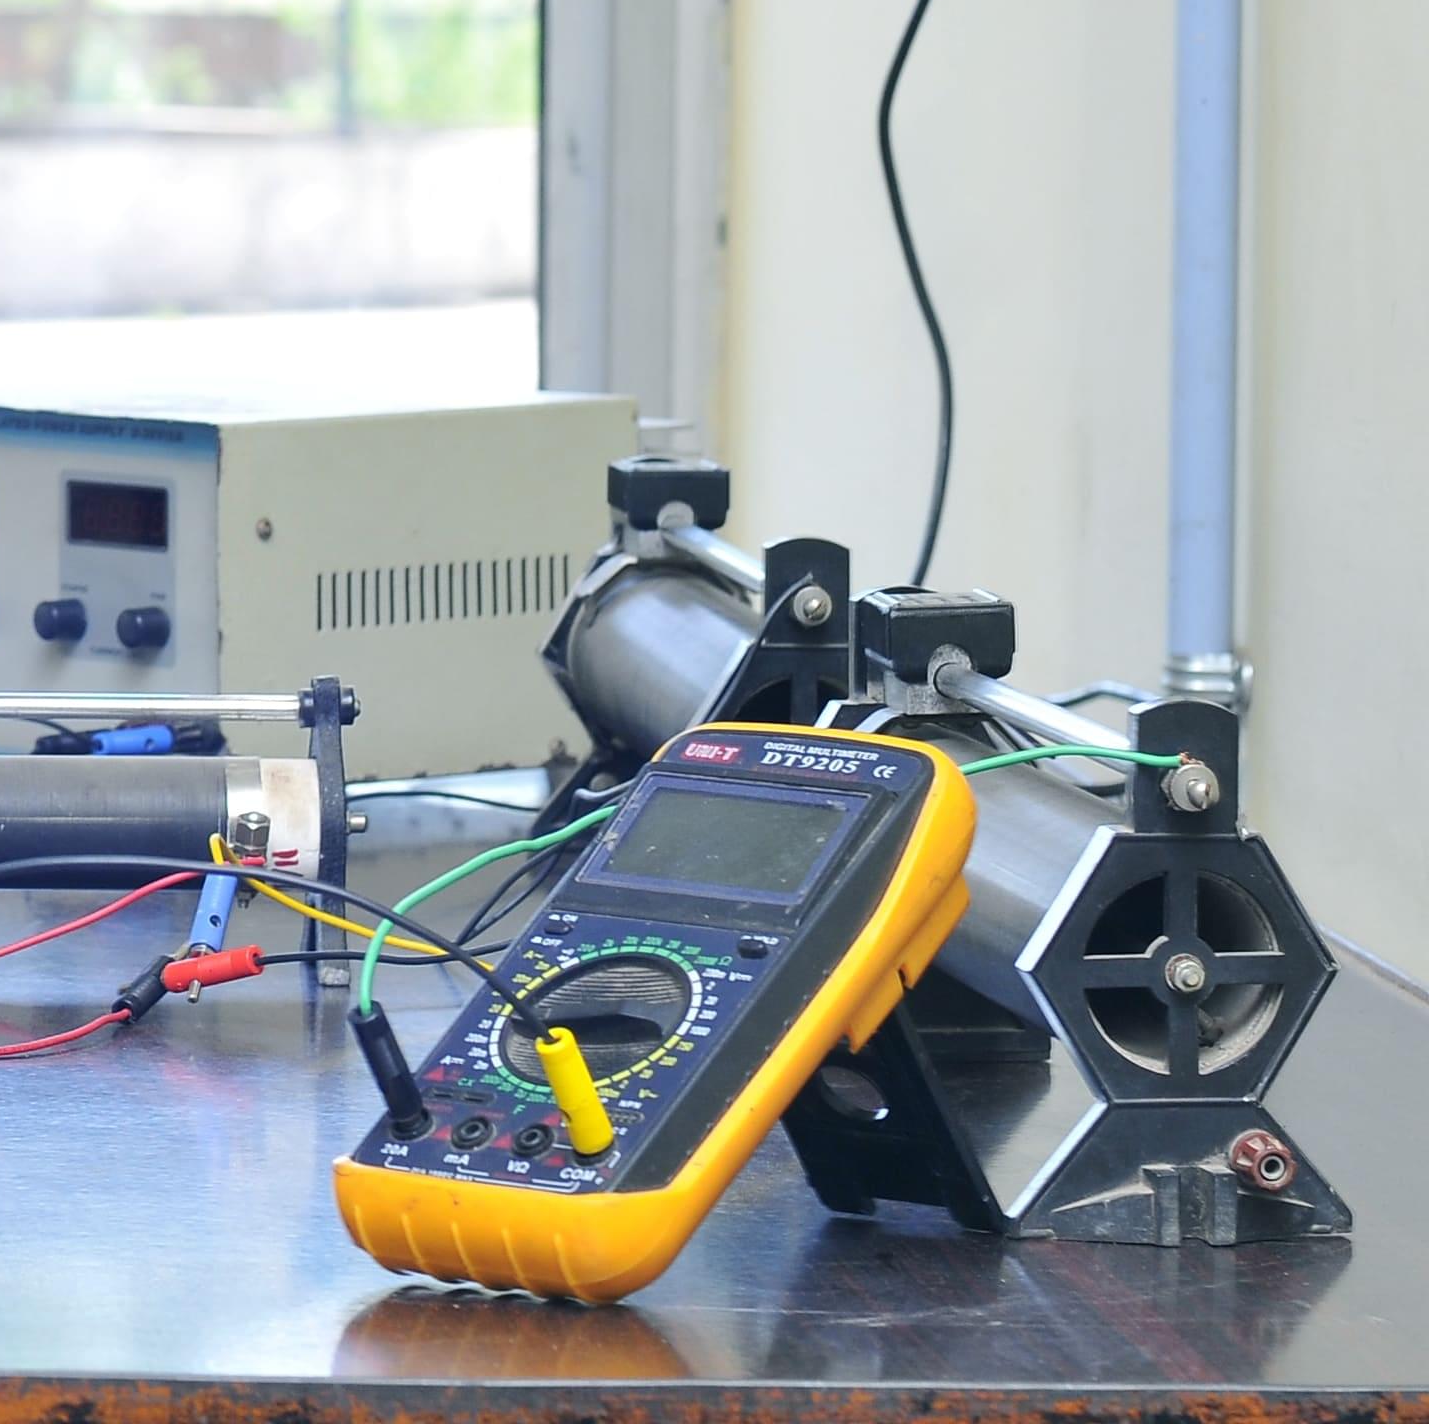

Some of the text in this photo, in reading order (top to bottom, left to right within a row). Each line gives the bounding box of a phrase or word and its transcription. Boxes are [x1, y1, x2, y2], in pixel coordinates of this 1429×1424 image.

[684, 742, 739, 761] UNI-T
[763, 741, 880, 762] DIGITAL MULTIMETER
[760, 750, 861, 775] DT9205
[380, 1143, 409, 1158] 20A
[443, 1153, 471, 1167] mA
[559, 1166, 598, 1182] COM
